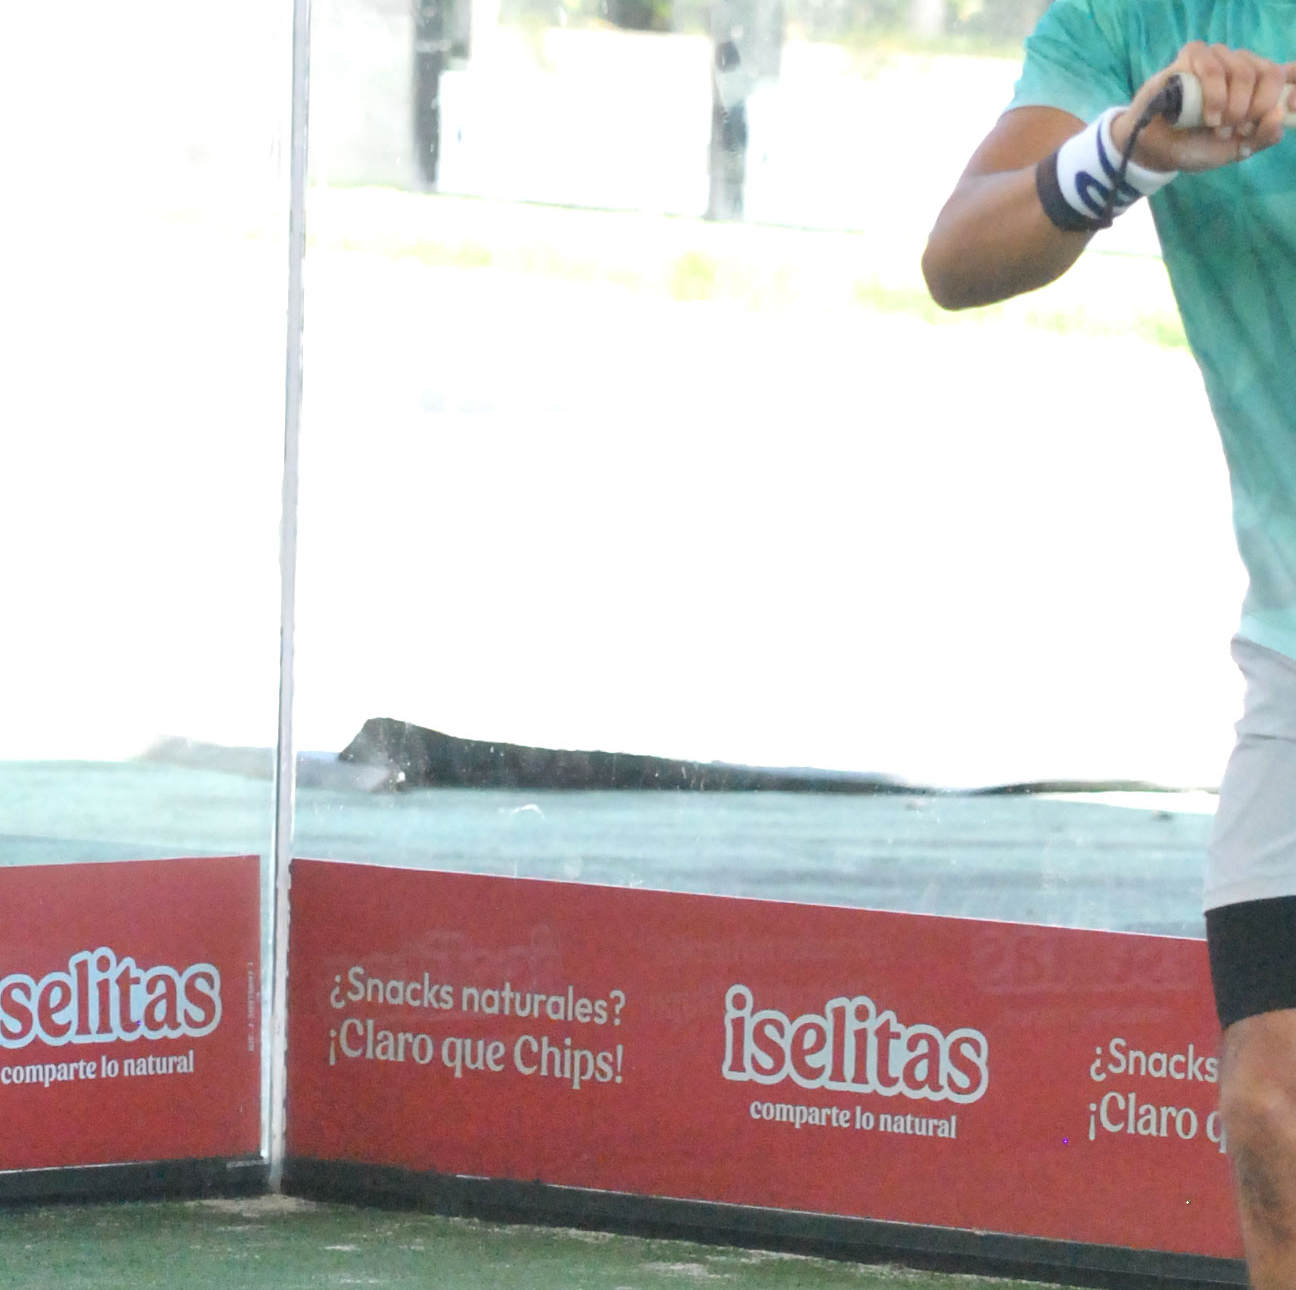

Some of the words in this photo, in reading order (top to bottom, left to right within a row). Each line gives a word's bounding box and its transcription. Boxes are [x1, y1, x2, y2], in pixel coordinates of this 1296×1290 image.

[330, 965, 454, 1009] ¿Snacks
[461, 981, 626, 1026] naturales?
[1, 1060, 97, 1088] comparte
[101, 1055, 118, 1078] lo
[123, 1049, 194, 1077] natural
[329, 1017, 434, 1066] ¡Claro
[441, 1036, 506, 1078] que
[513, 1034, 624, 1090] Chips!
[722, 984, 989, 1104] iselitas
[1090, 1037, 1219, 1083] ¿Snacks
[750, 1100, 850, 1128] comparte
[855, 1106, 874, 1130] lo
[879, 1113, 957, 1139] natural
[1088, 1091, 1198, 1141] ¡Claro
